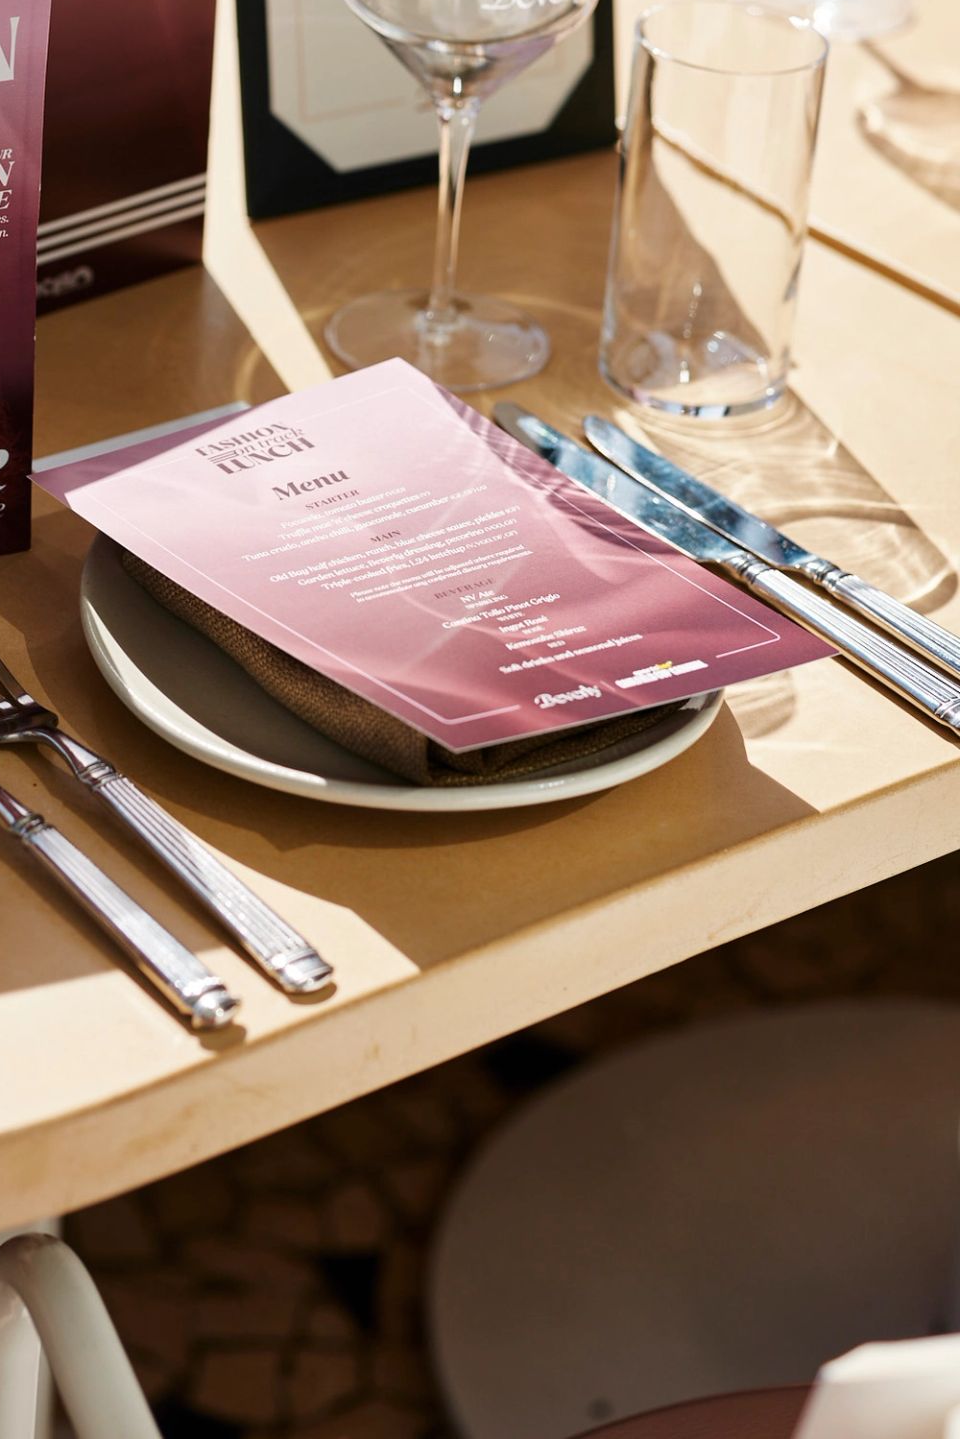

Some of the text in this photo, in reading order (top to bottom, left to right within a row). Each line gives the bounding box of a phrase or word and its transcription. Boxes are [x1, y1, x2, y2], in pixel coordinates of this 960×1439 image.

[194, 421, 292, 457] FASHION
[256, 427, 306, 449] track
[216, 436, 316, 474] LUNCH
[271, 469, 351, 501] Menu
[304, 489, 361, 510] STARTER
[355, 492, 384, 506] butter
[240, 551, 271, 562] Tuna
[405, 496, 449, 515] cucumber
[370, 529, 401, 543] MAIN
[269, 572, 289, 583] Old
[288, 568, 309, 578] Bay
[307, 561, 328, 573] half
[328, 553, 367, 567] chicken,
[394, 536, 416, 548] blue
[428, 545, 466, 561] ketchup
[297, 571, 335, 586] Garden
[434, 577, 495, 599] BEVERAGE
[504, 601, 532, 614] Pinot
[529, 593, 561, 607] Grigio
[533, 683, 603, 709] Beverly
